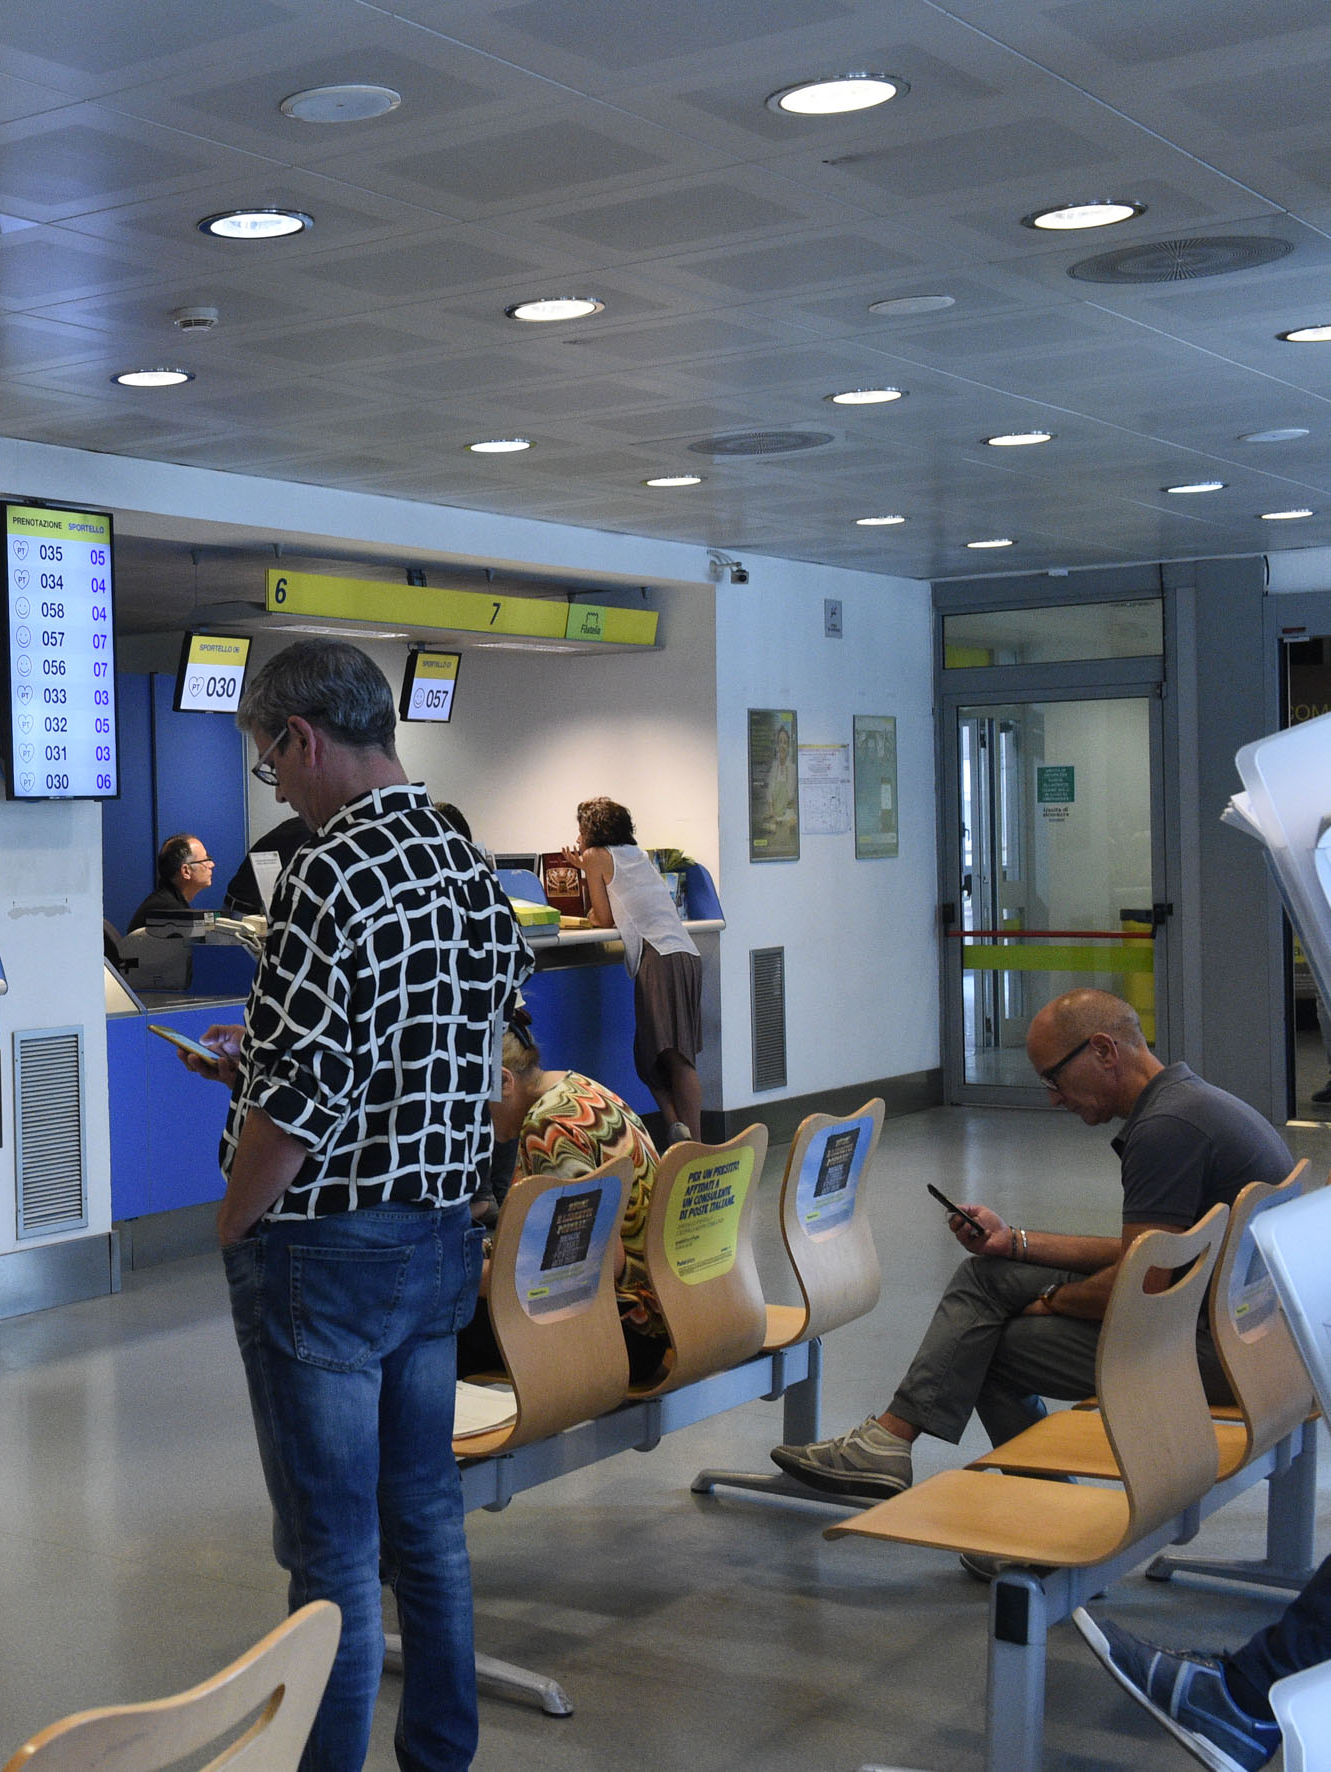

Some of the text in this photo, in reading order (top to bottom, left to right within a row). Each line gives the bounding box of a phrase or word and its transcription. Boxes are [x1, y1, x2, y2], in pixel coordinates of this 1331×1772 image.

[12, 516, 105, 534] PRENOTAZIONE SPORTELLO
[39, 544, 63, 562] 035
[90, 549, 106, 566] 05
[40, 573, 64, 590] 034
[91, 577, 106, 594] 04
[274, 577, 288, 604] 6
[41, 602, 107, 622] 058 04
[489, 602, 502, 626] 7
[42, 630, 107, 650] 057 07
[43, 659, 108, 678] 056 07
[43, 687, 67, 704] 033
[94, 689, 109, 706] 03
[206, 676, 237, 698] 030
[426, 689, 449, 709] 057
[44, 716, 68, 733] 032
[95, 717, 110, 733] 05
[45, 745, 67, 761] 031
[95, 745, 111, 762] 03
[46, 773, 69, 790] 030
[96, 773, 111, 789] 06
